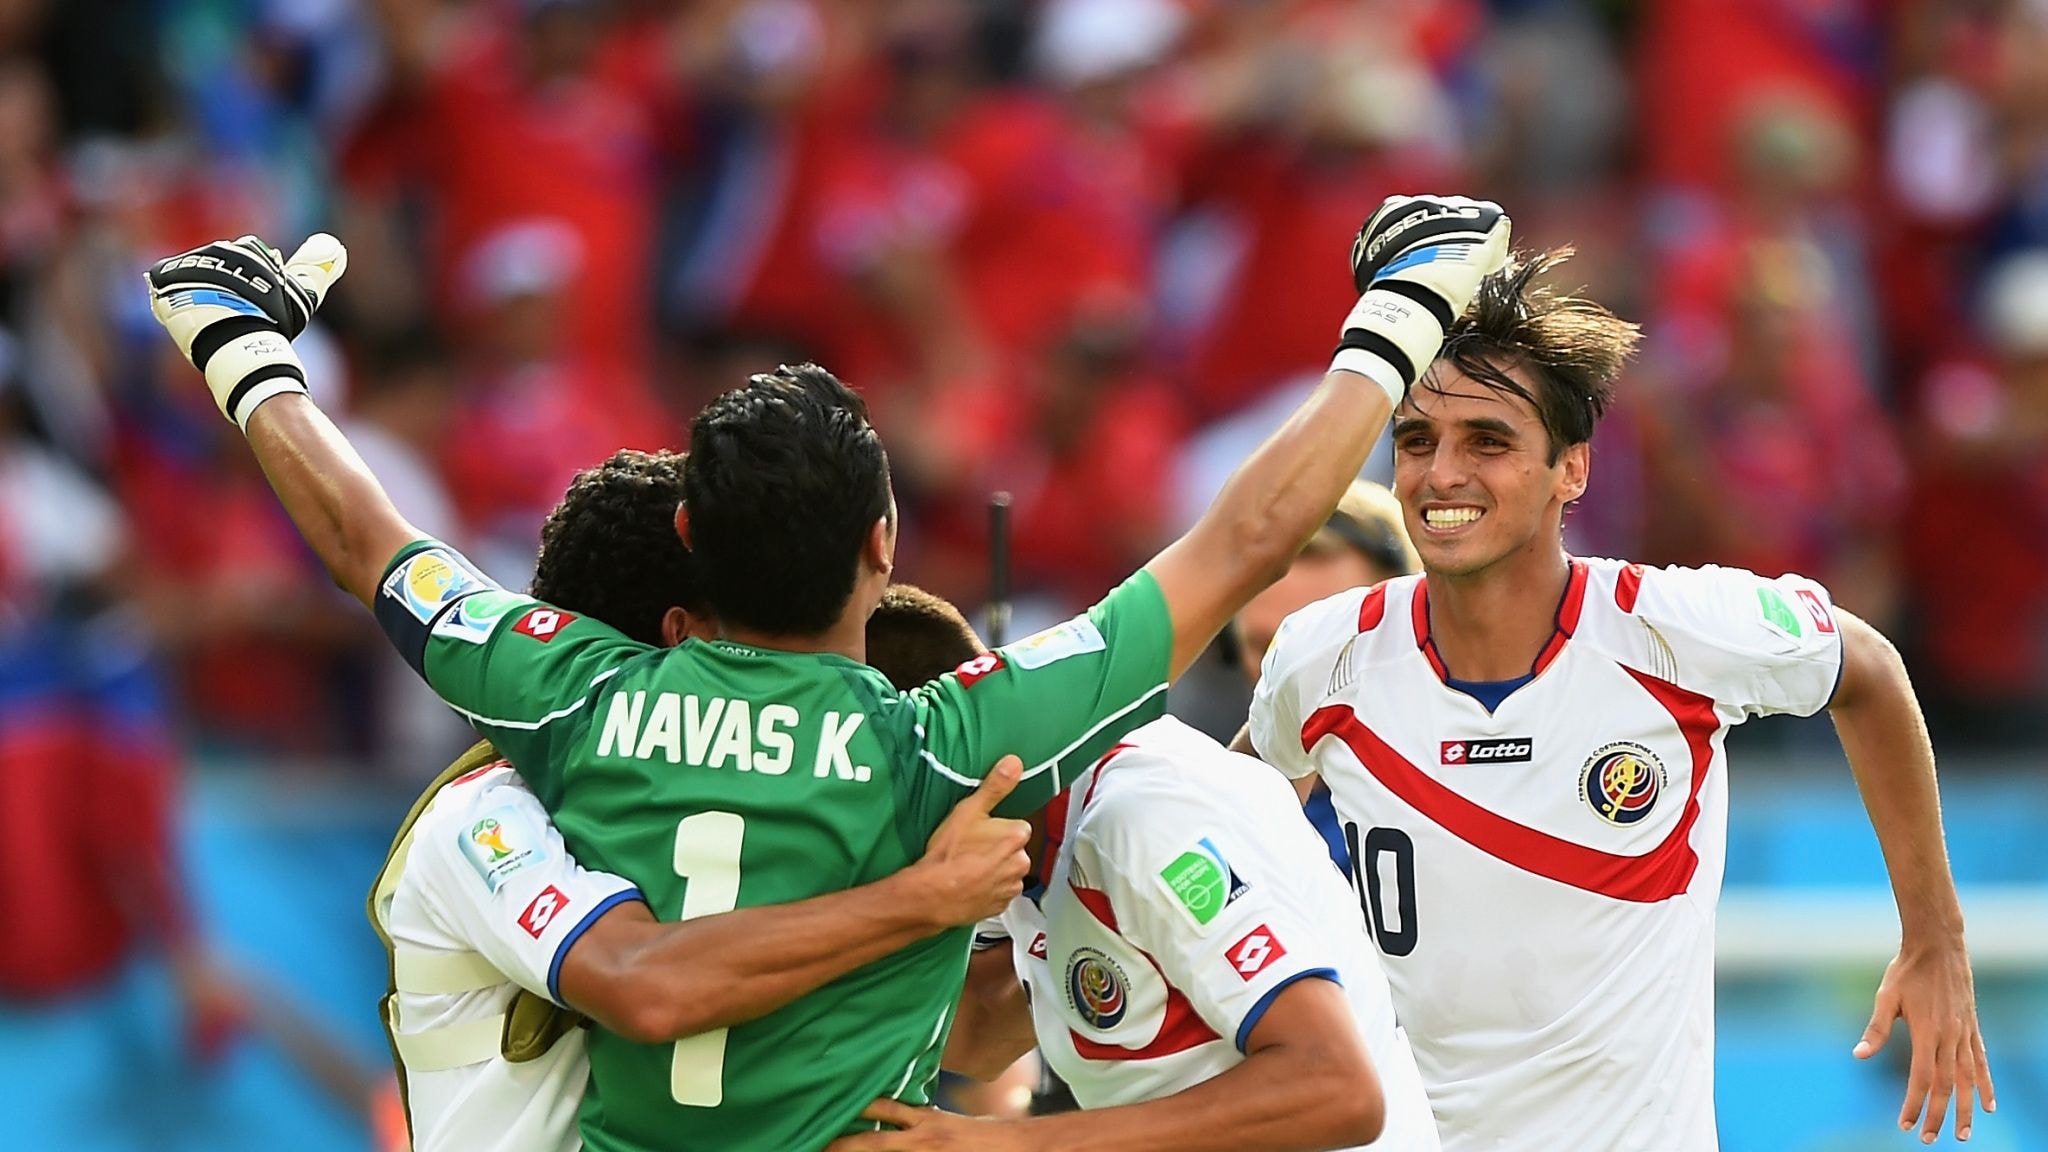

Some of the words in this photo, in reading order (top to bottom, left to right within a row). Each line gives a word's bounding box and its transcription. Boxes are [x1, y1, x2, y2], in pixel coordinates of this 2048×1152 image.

[1384, 206, 1481, 243] SELLS
[178, 255, 272, 294] SELLS
[597, 690, 800, 775] NAVAS
[813, 711, 872, 782] K.
[671, 811, 745, 1107] 1
